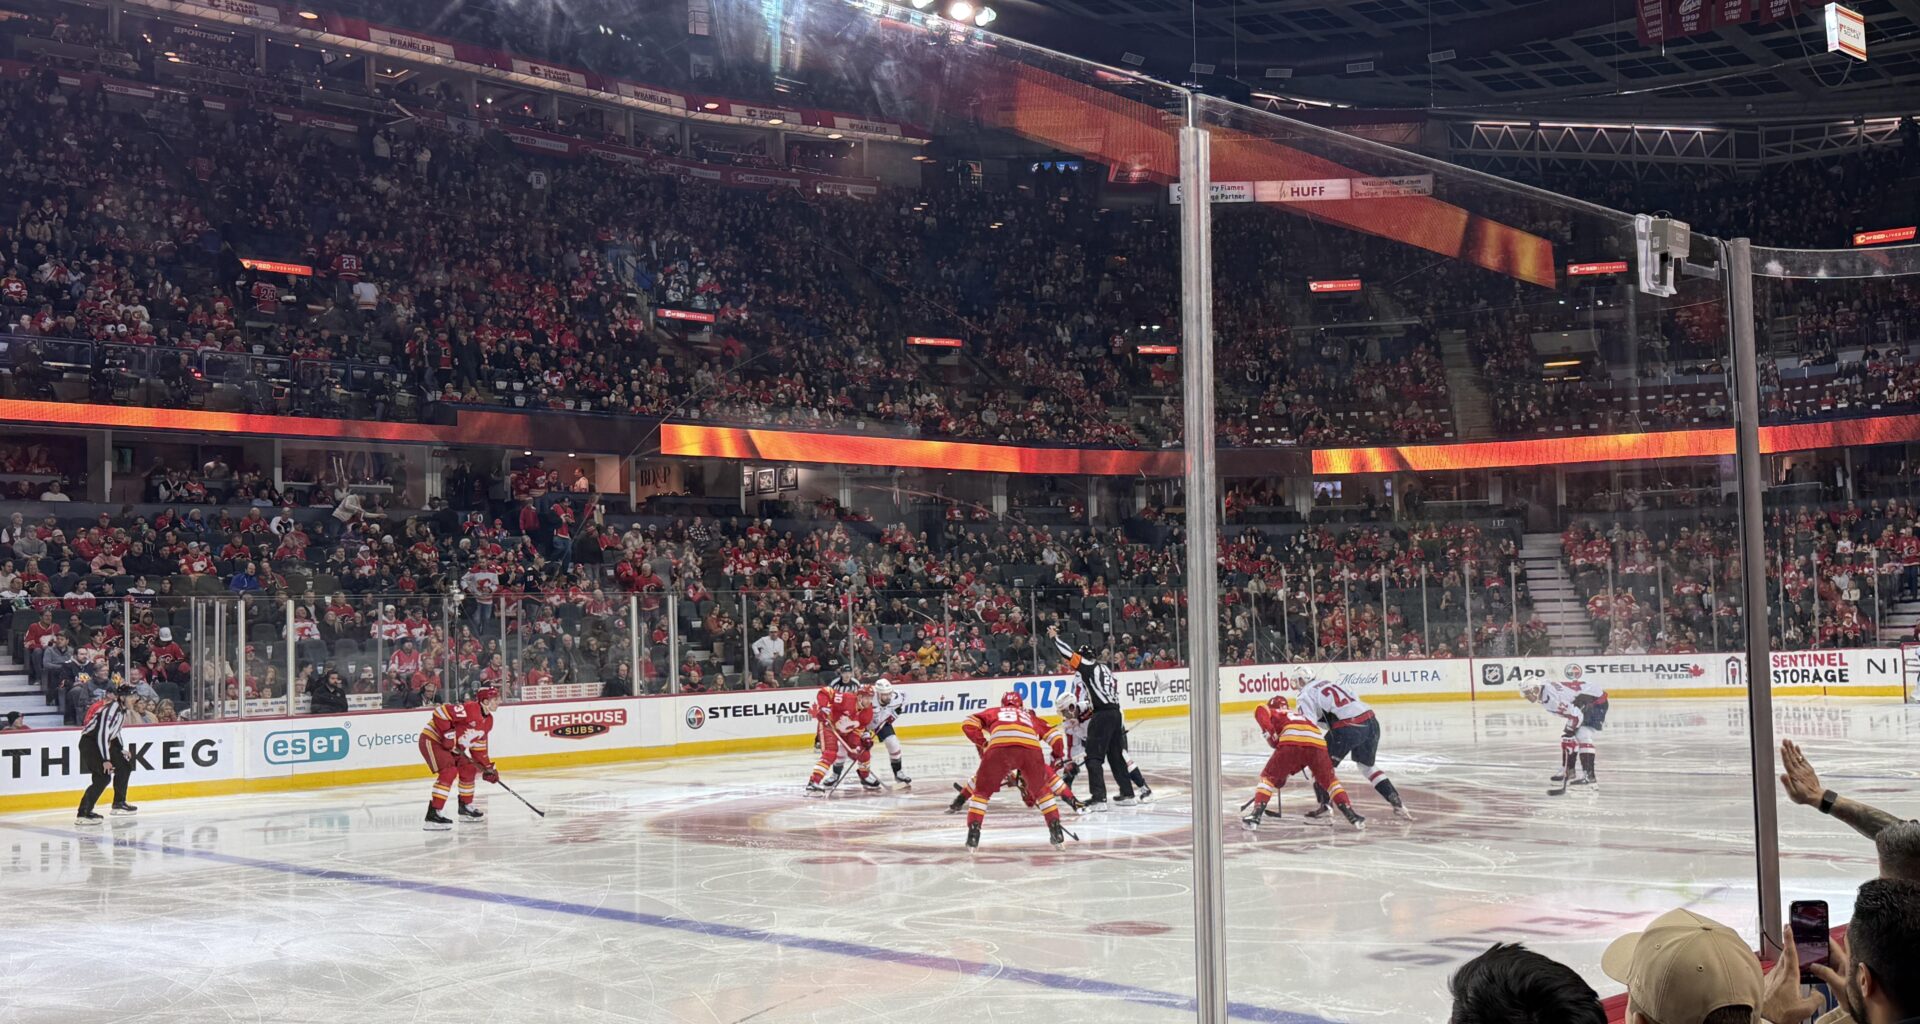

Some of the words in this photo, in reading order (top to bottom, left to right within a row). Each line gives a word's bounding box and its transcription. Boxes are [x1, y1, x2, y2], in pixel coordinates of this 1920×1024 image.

[173, 26, 234, 43] SPORTSNET
[389, 37, 436, 54] WRANGLERS
[520, 137, 537, 145] RED
[1220, 184, 1244, 192] Flames
[1291, 186, 1325, 197] HUFF
[1221, 193, 1246, 201] Partner
[342, 258, 357, 270] 23
[467, 513, 484, 523] 10
[1492, 519, 1505, 527] 117
[1772, 653, 1849, 668] SENTINEL
[1585, 663, 1690, 674] STEELHAUS
[1338, 672, 1379, 686] Michelob
[1391, 670, 1441, 683] ULTRA
[1773, 669, 1850, 683] STORAGE
[1013, 680, 1075, 709] PIZZ
[1126, 681, 1158, 701] GREY
[708, 701, 810, 719] STEELHAUS
[902, 695, 954, 714] untain
[958, 693, 987, 711] Tire
[453, 704, 468, 718] 37
[534, 710, 625, 731] FIREHOUSE
[564, 726, 595, 736] SUBS
[357, 732, 420, 750] Cybersec
[128, 739, 219, 772] KEG
